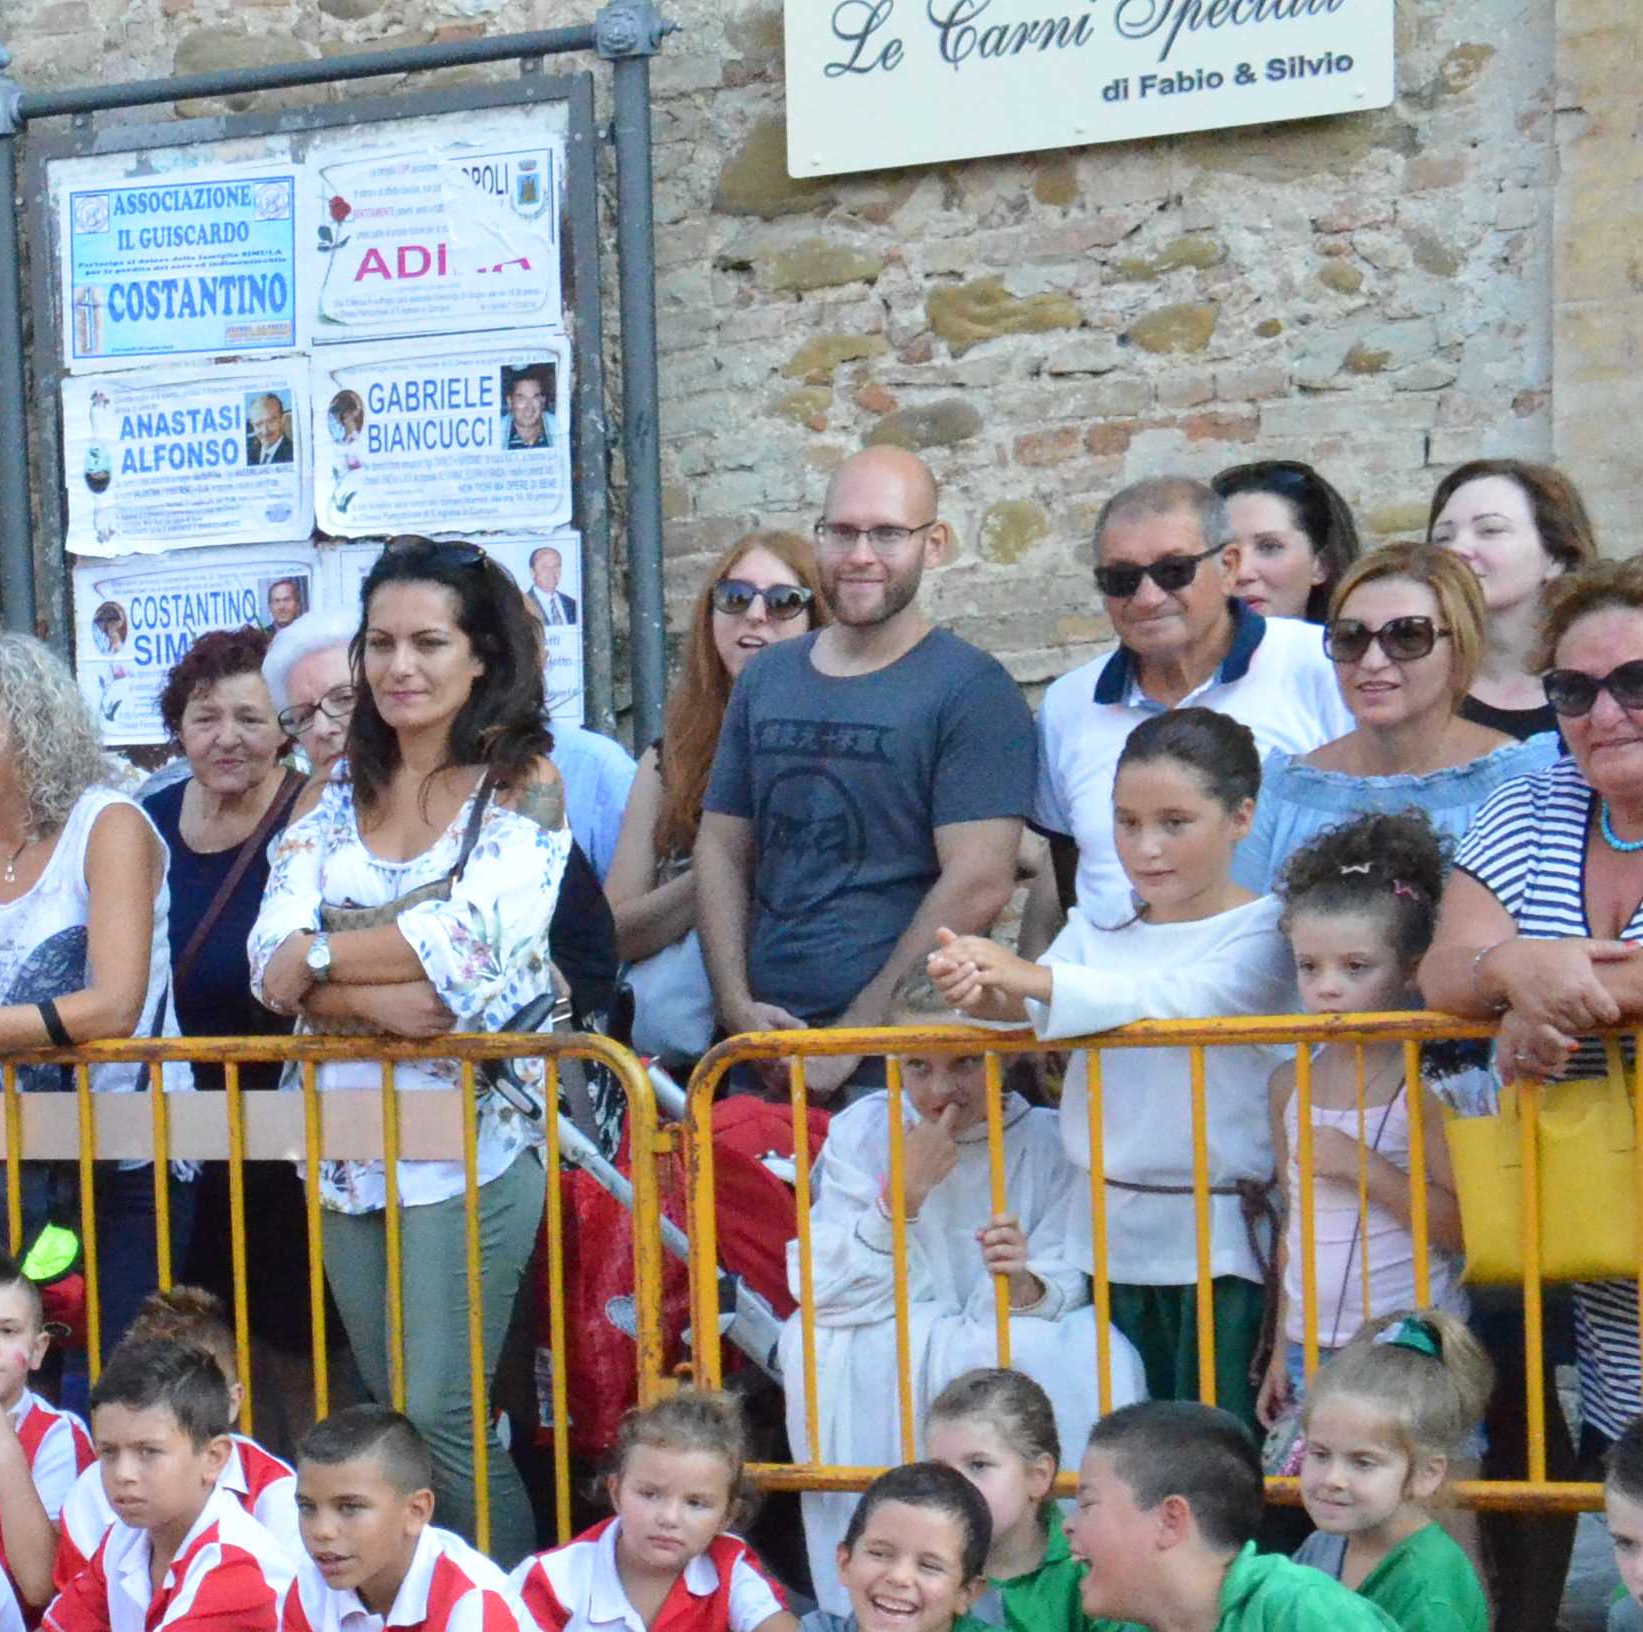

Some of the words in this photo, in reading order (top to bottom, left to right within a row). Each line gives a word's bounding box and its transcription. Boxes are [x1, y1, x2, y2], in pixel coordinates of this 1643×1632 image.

[824, 0, 904, 78] Le
[927, 0, 1096, 71] Carni
[1102, 78, 1131, 102] di
[1140, 65, 1223, 98] Fabio
[1234, 60, 1257, 86] &
[1266, 52, 1354, 81] Silvio
[462, 163, 509, 195] POLI
[113, 185, 252, 216] ASSOCIAZIONE
[118, 230, 134, 250] IL
[139, 221, 250, 249] GUISCARDO
[108, 272, 287, 323] COSTANTINO
[368, 376, 494, 414] GABRIELE
[120, 404, 241, 440] ANASTASI
[368, 417, 493, 454] BIANCUCCI
[121, 438, 239, 474] ALFONSO
[130, 589, 257, 630] COSTANTINO
[134, 633, 192, 666] SIM
